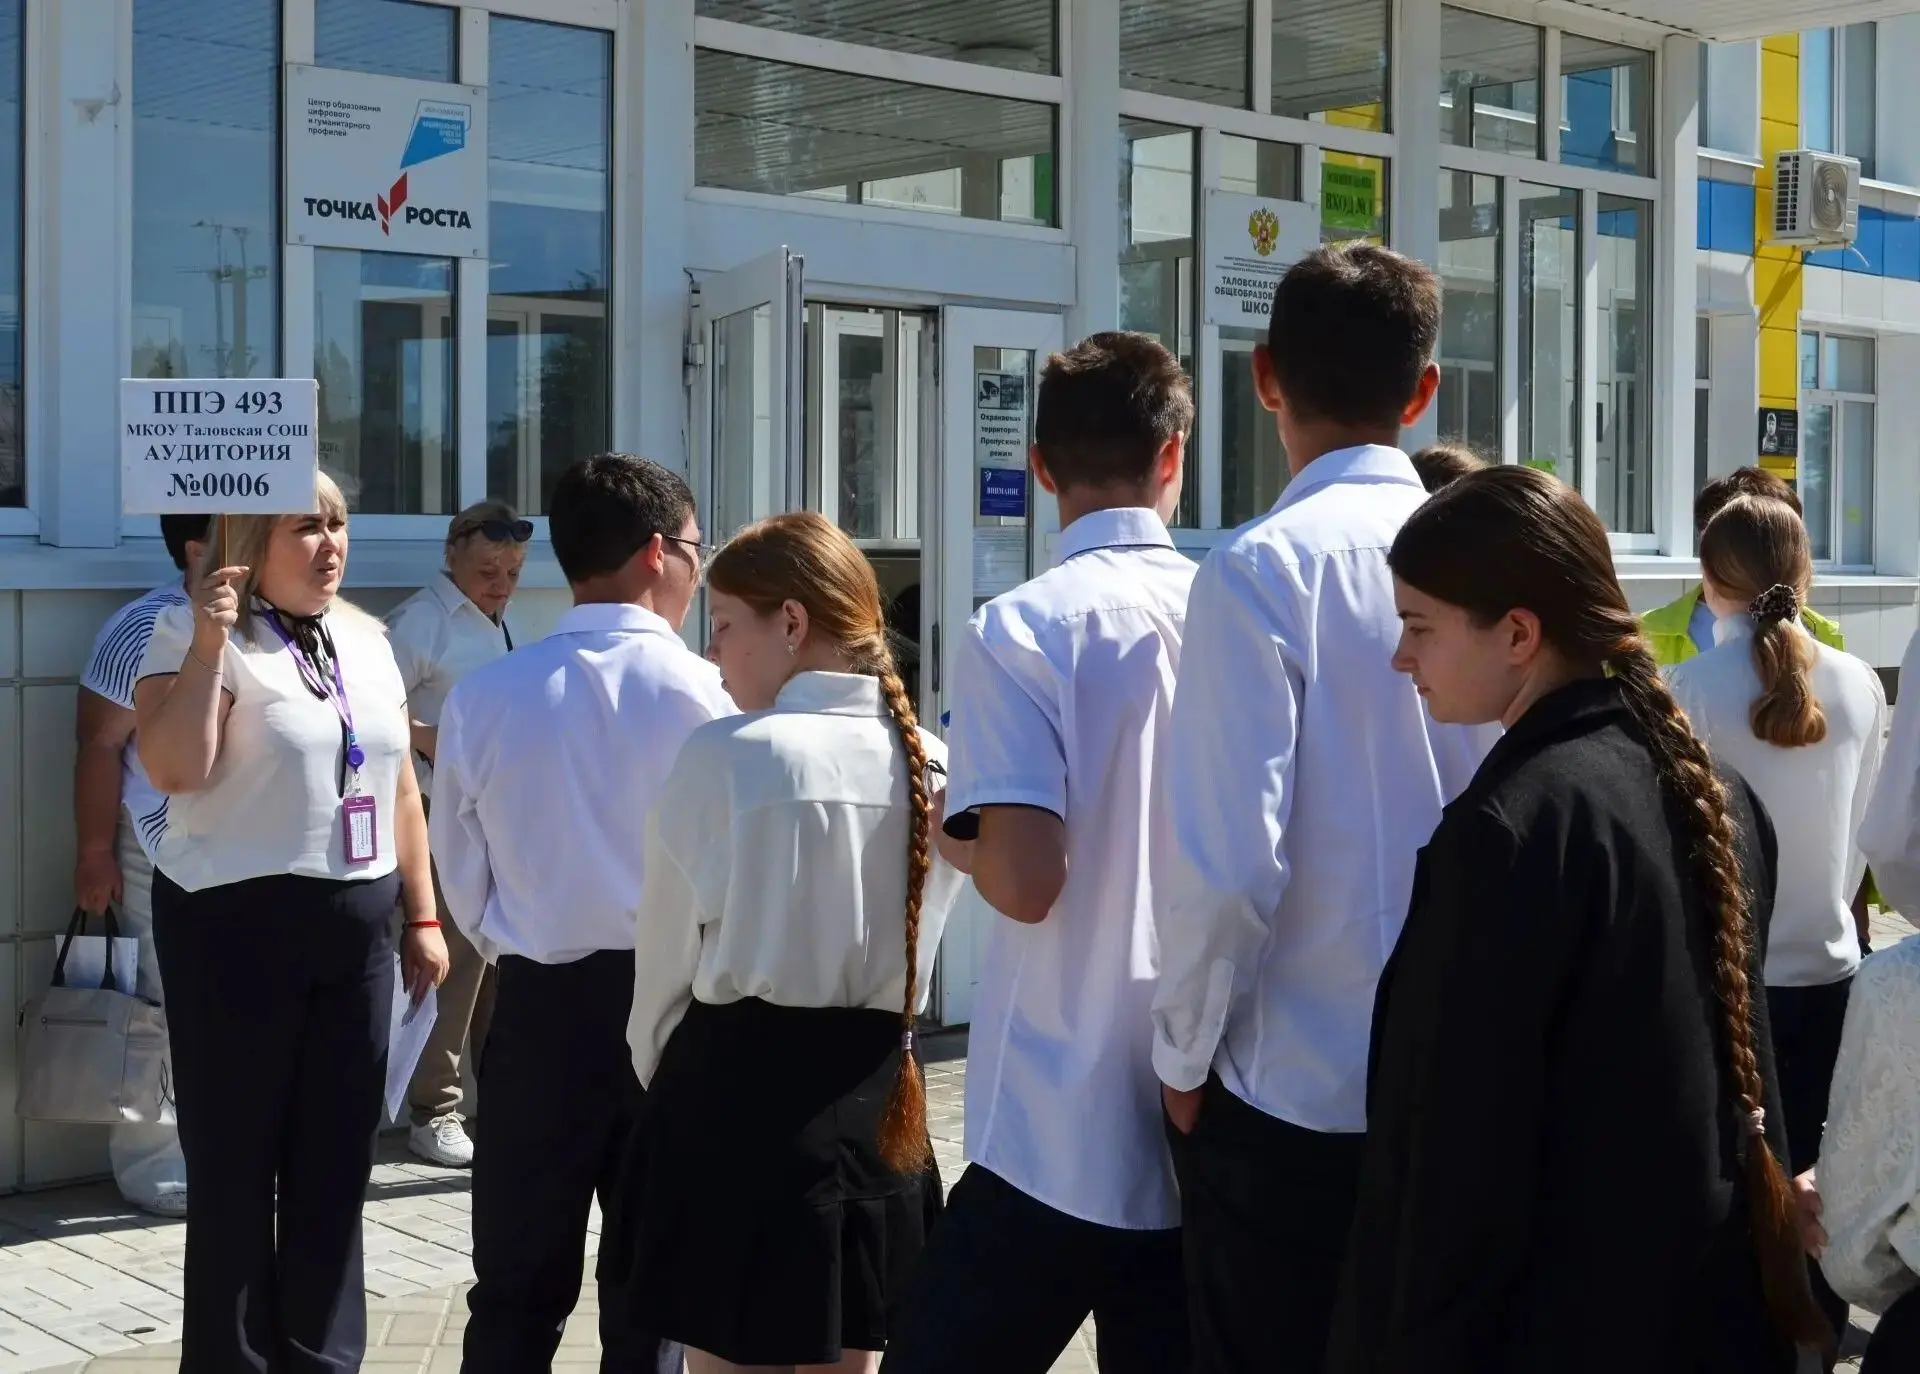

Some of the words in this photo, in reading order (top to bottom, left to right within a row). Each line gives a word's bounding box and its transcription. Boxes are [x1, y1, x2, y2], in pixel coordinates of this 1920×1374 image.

[308, 98, 331, 108] Центр
[333, 101, 381, 112] образования
[308, 109, 350, 118] цифрового
[314, 118, 370, 130] гуманитарного
[308, 127, 347, 137] профилей
[304, 198, 376, 221] ТОЧКА
[406, 206, 471, 229] РОСТА
[1222, 276, 1268, 289] ТАЛОВСКАЯ
[1215, 286, 1276, 300] ОБЩЕОБРАЗОВ
[152, 391, 226, 415] ППЭ
[234, 391, 284, 415] 493
[127, 424, 179, 437] МКОУ
[184, 424, 263, 437] Таловская
[267, 424, 308, 437] СОШ
[144, 444, 292, 464] АУДИТОРИЯ
[990, 450, 1013, 458] режим
[167, 472, 270, 497] №0006
[986, 486, 1020, 496] ВНИМАНИЕ
